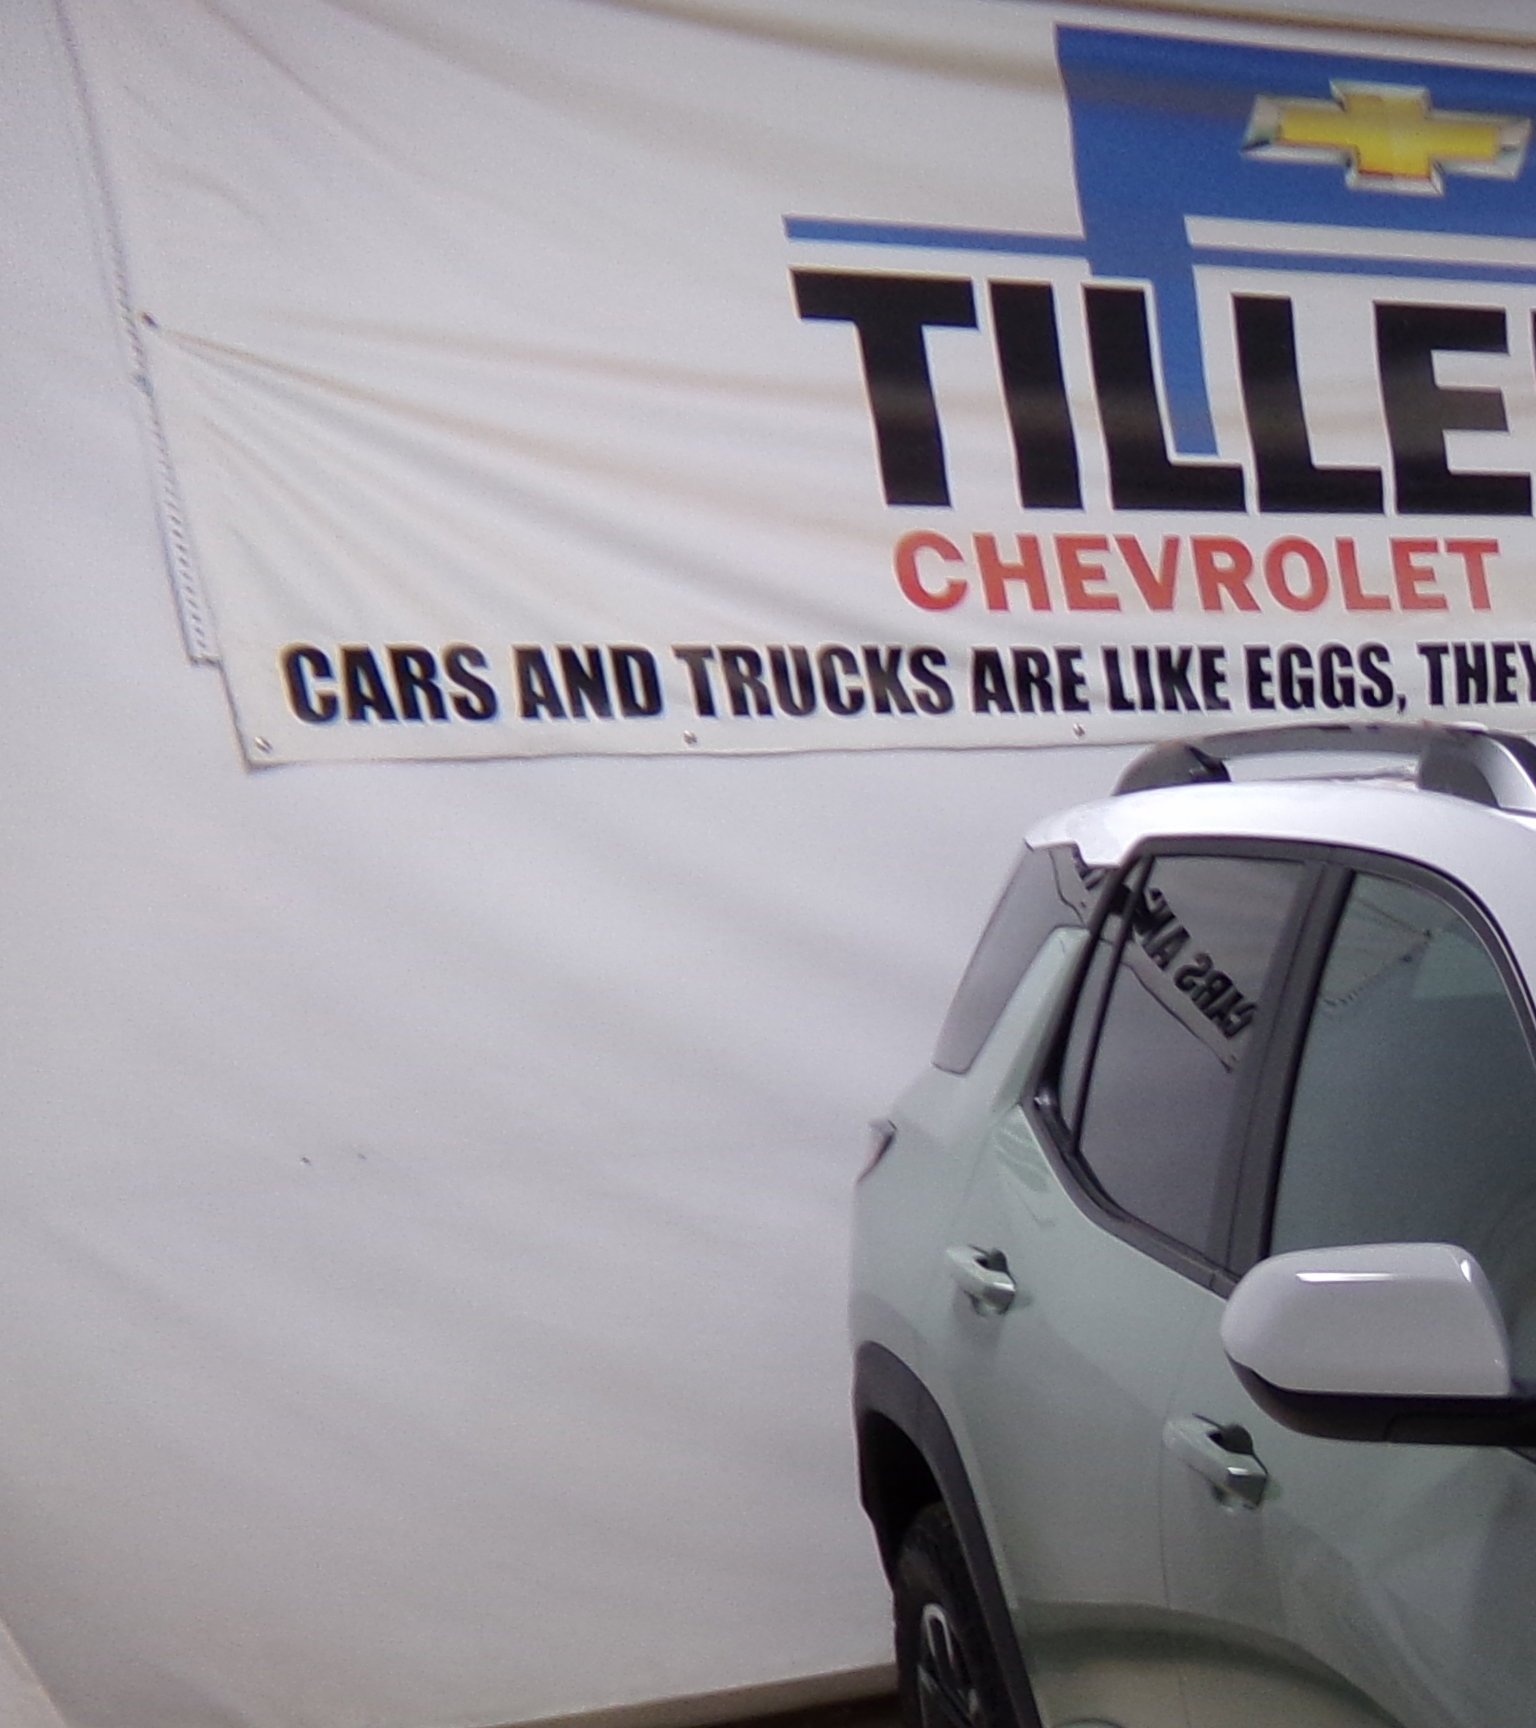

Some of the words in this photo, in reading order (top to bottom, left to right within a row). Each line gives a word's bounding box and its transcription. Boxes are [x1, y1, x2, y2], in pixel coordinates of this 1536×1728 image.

[893, 530, 1500, 613] CHEVROLET
[281, 643, 498, 724] CARS
[514, 646, 662, 722] AND
[672, 645, 954, 718] TRUCKS
[970, 645, 1091, 715] ARE
[1102, 643, 1232, 711] LIKE
[1244, 641, 1406, 713] EGGS,
